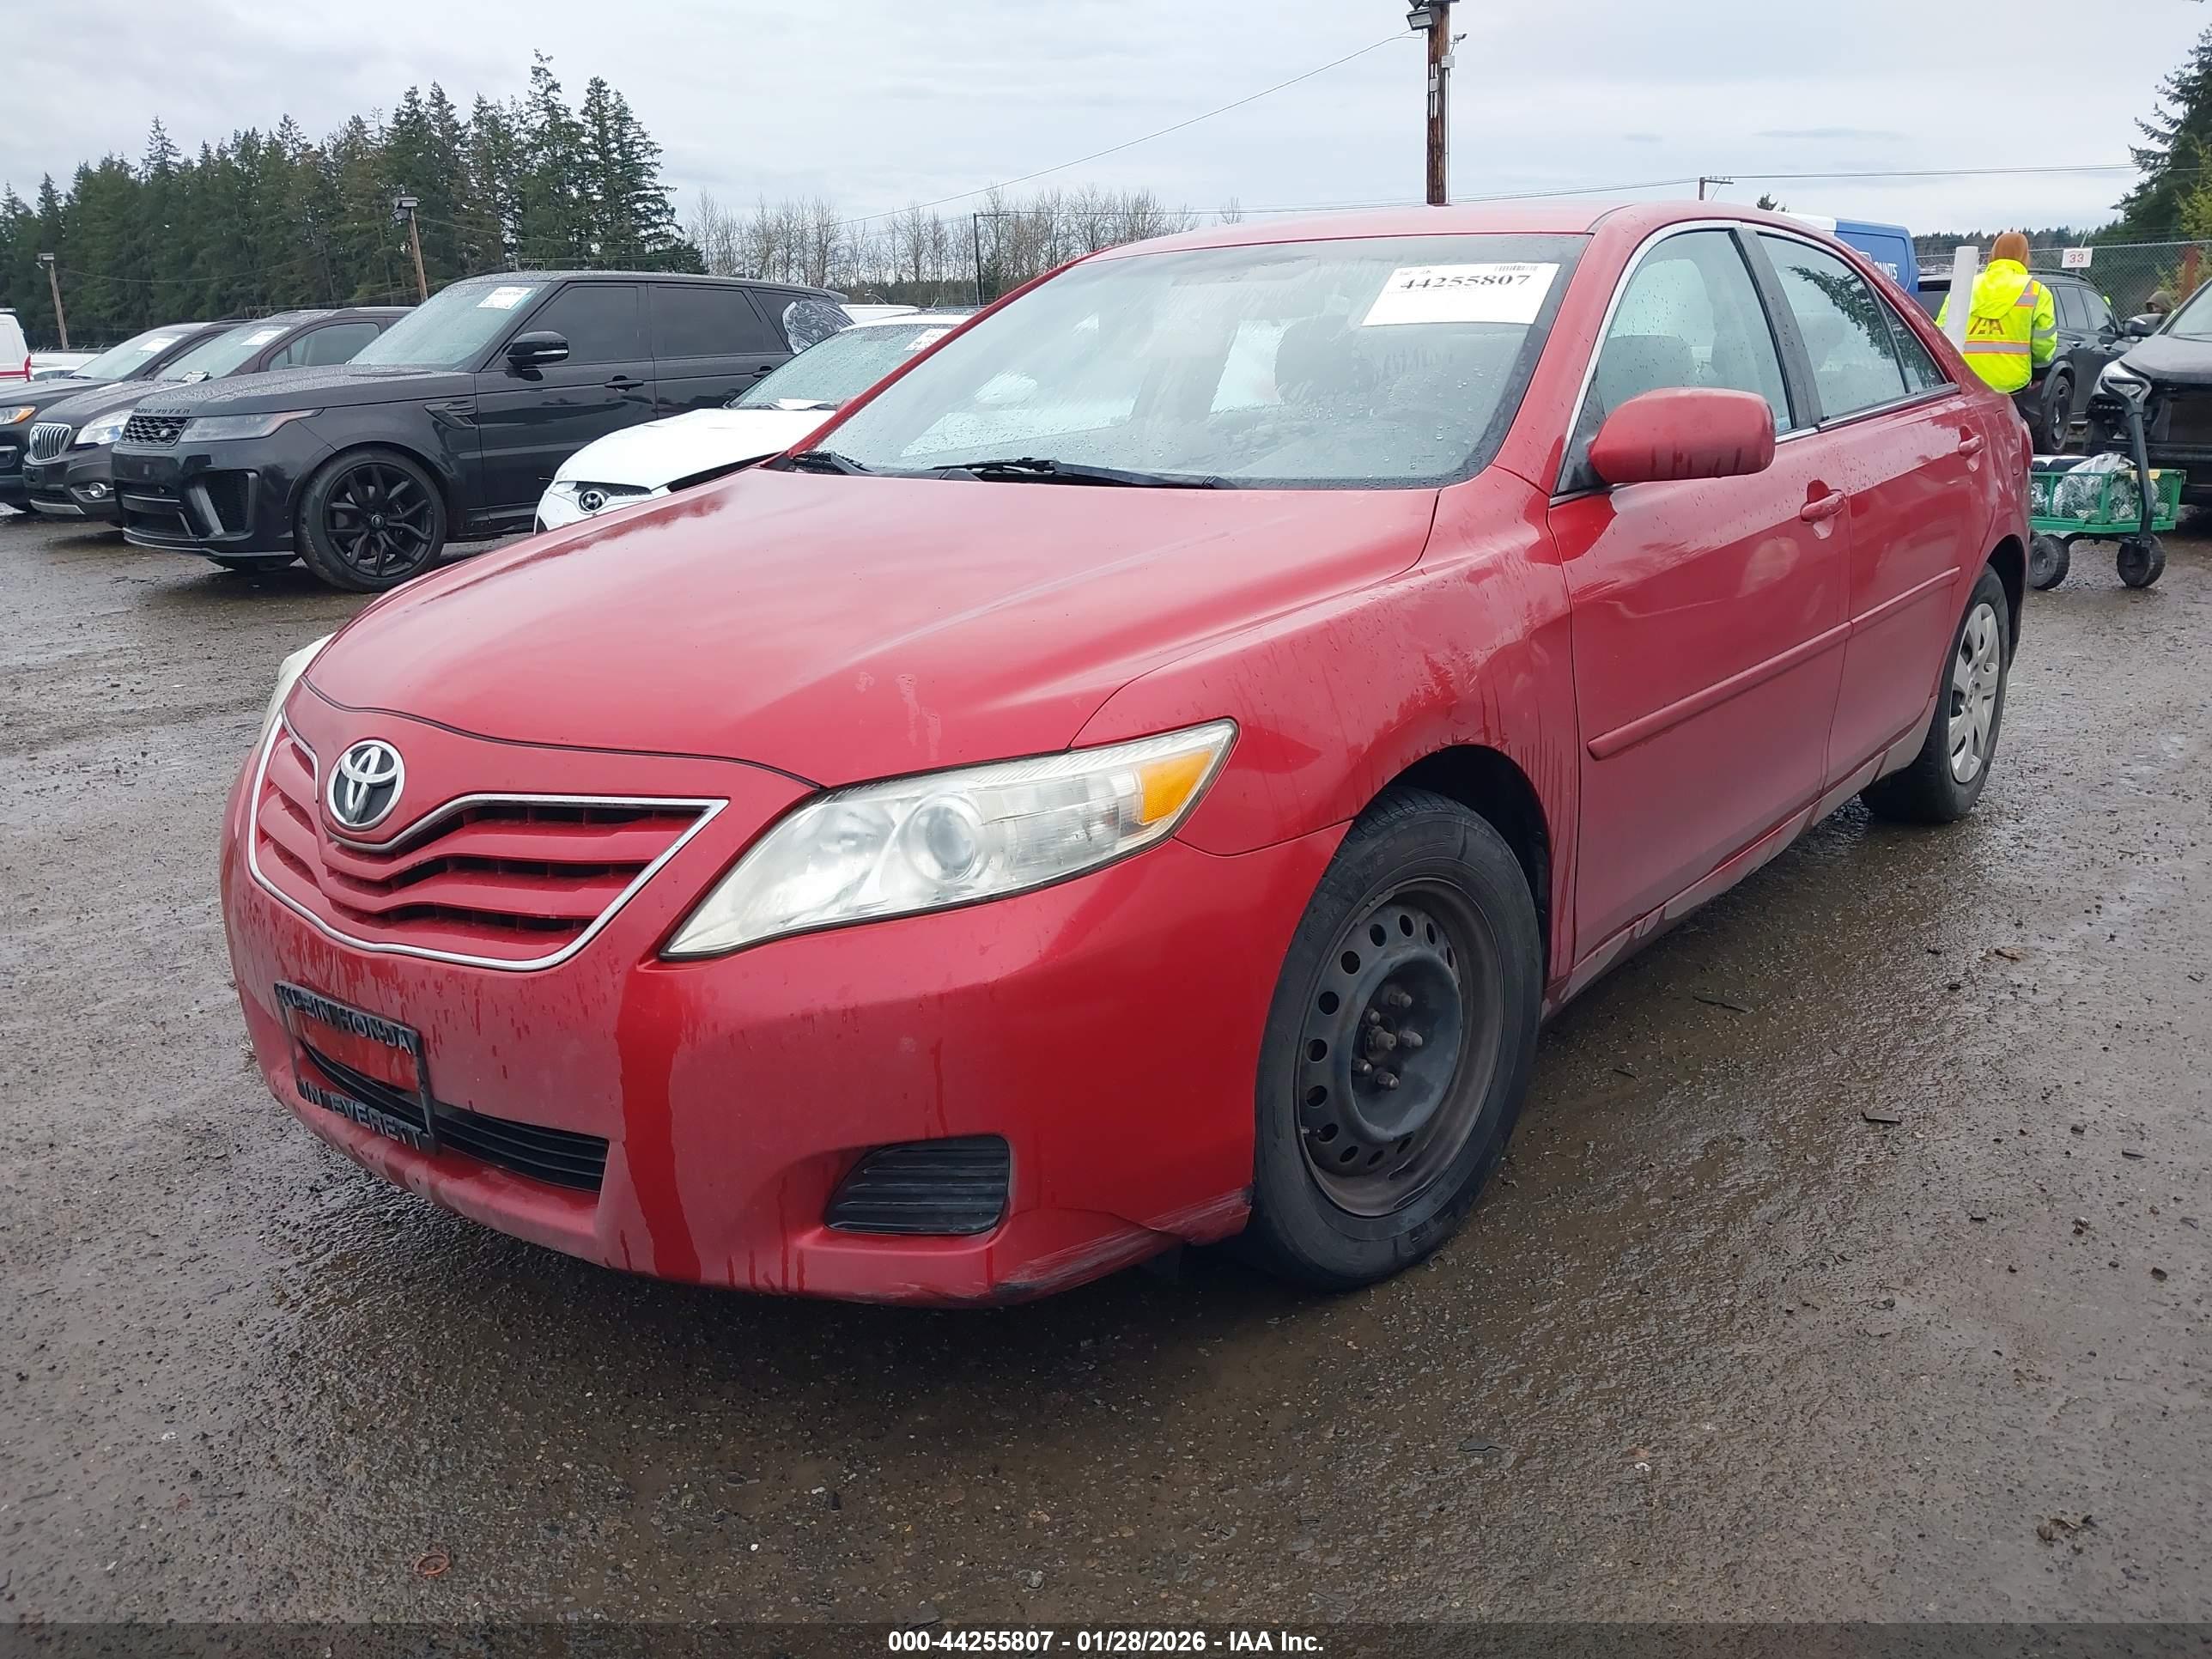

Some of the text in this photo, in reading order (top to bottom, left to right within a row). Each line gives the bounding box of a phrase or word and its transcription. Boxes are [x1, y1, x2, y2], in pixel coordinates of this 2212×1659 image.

[2069, 253, 2084, 264] 33
[1400, 274, 1531, 289] 44255807
[278, 984, 411, 1054] KLEIN HONDA
[302, 1080, 422, 1151] IN EVERETT
